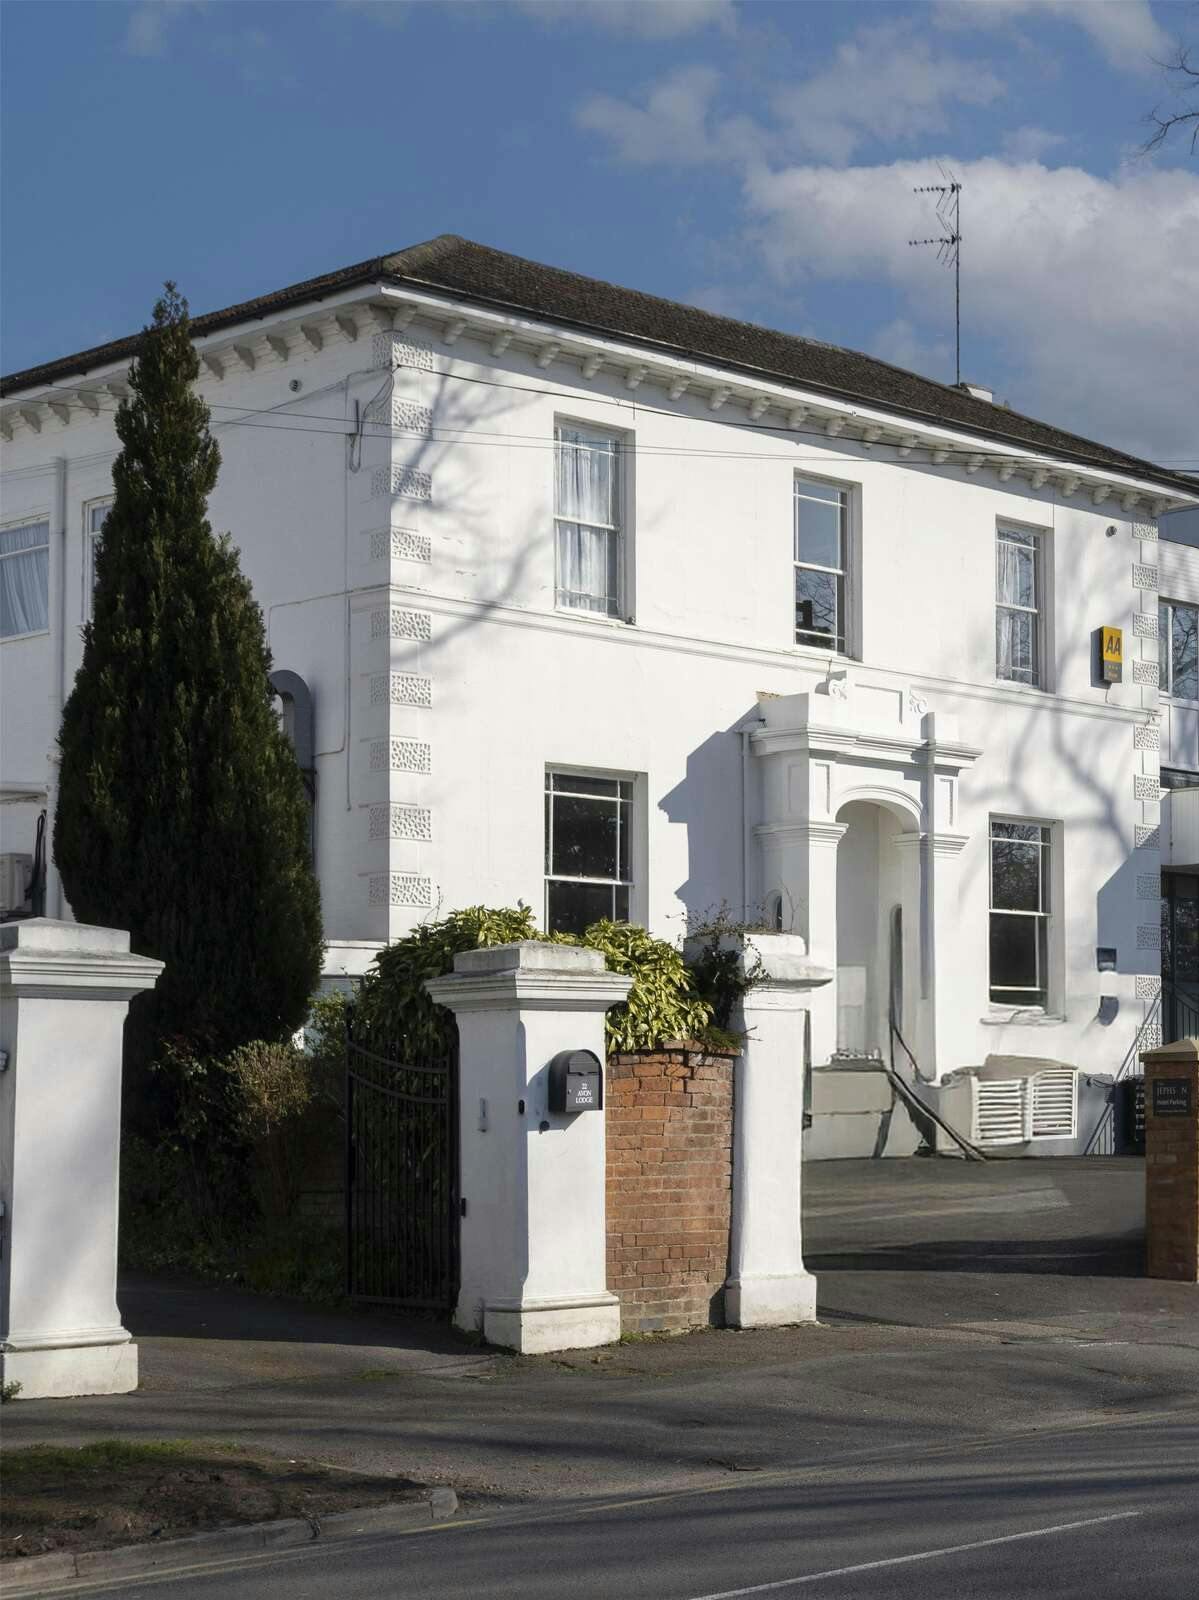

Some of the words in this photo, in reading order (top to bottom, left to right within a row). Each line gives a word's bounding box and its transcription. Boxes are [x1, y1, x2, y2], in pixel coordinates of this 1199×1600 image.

[1105, 635, 1121, 656] AA
[1156, 1086, 1187, 1097] JEPHSN
[575, 1096, 593, 1104] LODGE
